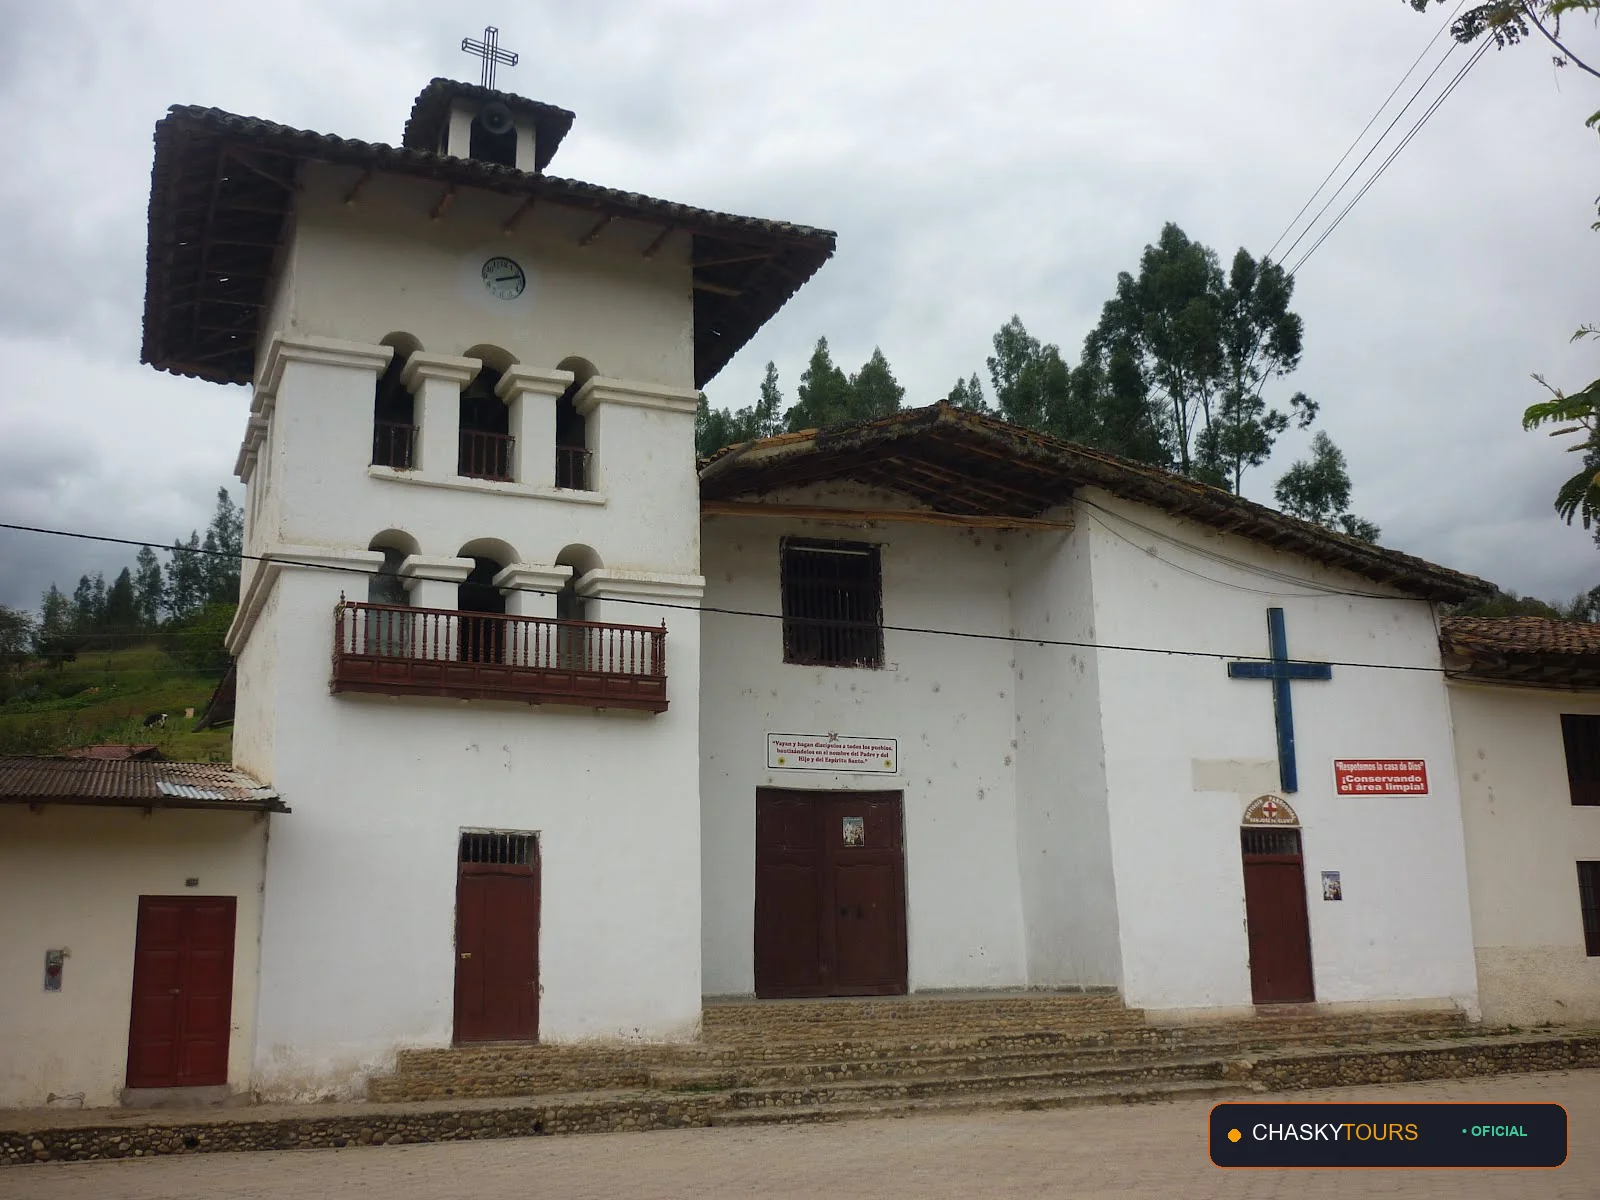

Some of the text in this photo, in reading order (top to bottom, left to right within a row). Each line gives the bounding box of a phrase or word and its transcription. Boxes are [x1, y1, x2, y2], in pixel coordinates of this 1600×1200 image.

[1336, 761, 1376, 772] "Respetemos
[1376, 762, 1383, 770] la
[1384, 763, 1398, 771] casa
[1400, 762, 1407, 771] de
[1342, 775, 1422, 784] ¡Conservando
[1356, 783, 1382, 791] área
[1385, 783, 1424, 792] limpia!
